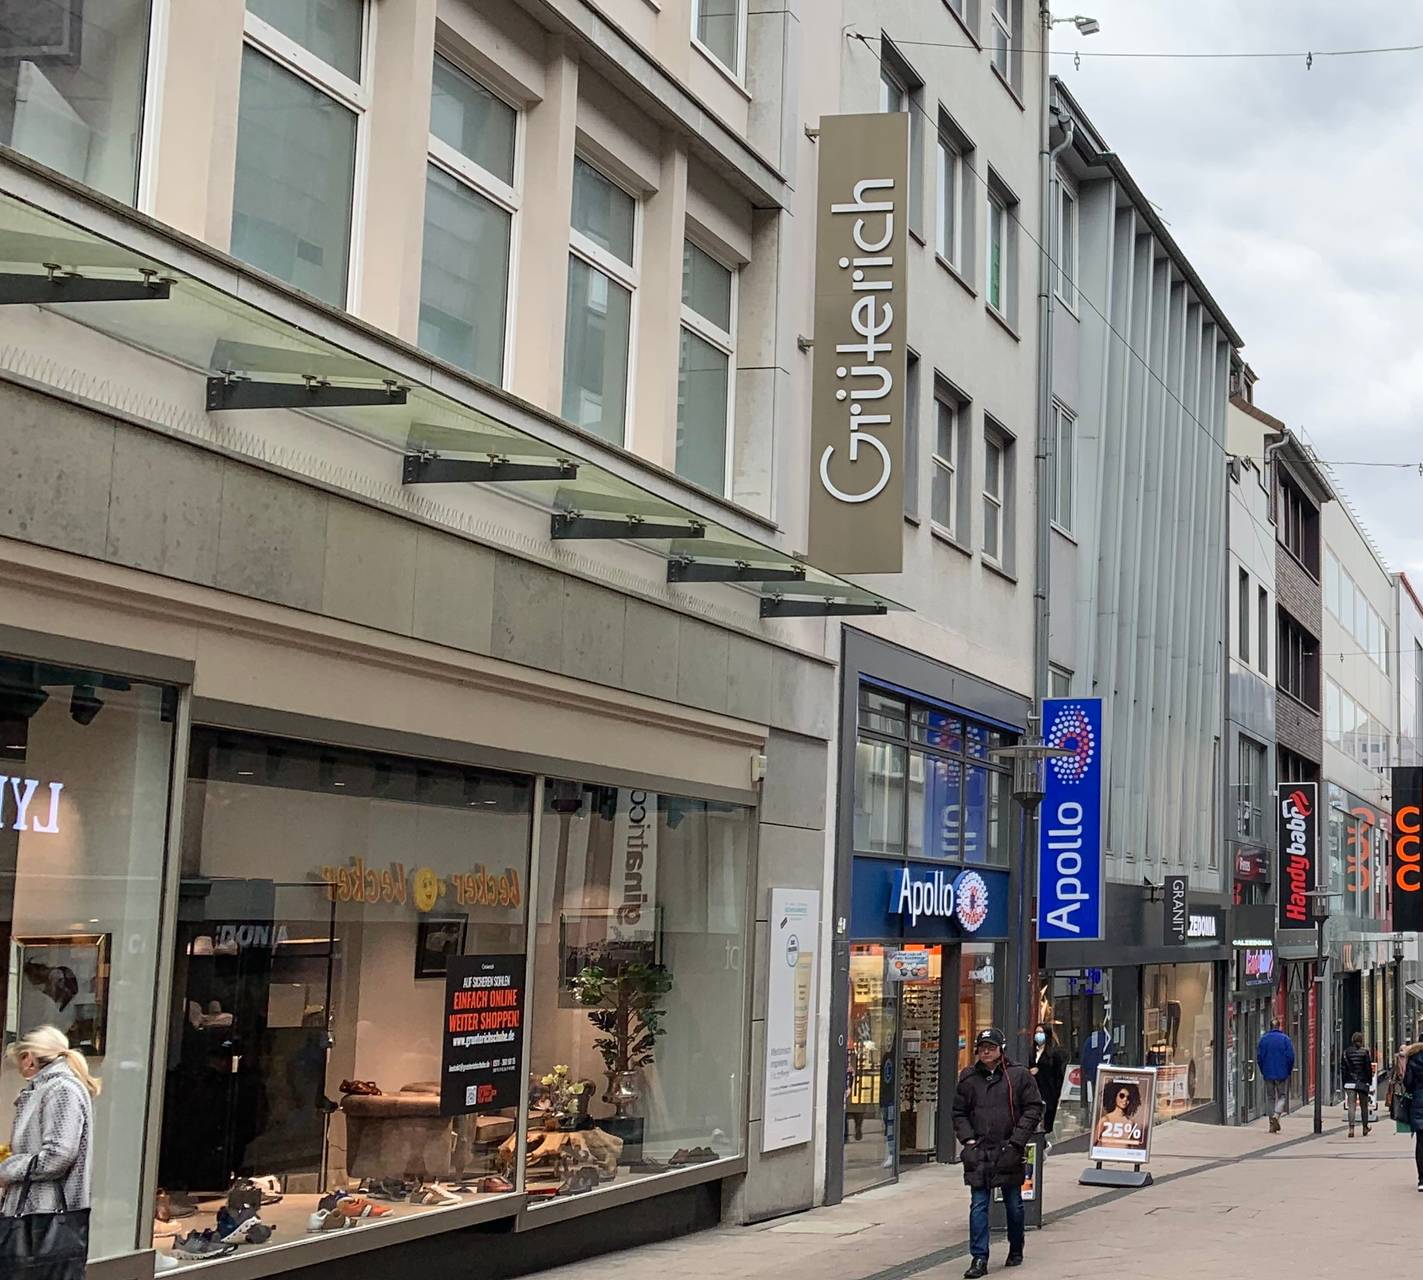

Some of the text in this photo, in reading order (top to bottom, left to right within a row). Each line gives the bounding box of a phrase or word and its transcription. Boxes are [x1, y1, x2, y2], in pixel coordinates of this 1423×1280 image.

[819, 178, 895, 503] Grüterich
[1046, 801, 1090, 934] Apollo
[1395, 805, 1421, 893] CCC
[897, 867, 955, 928] Apollo
[1187, 915, 1217, 937] ZEDONIA
[453, 989, 518, 1010] EINFACH ONLINE
[448, 1010, 520, 1033] WEITER SHOPPEN!
[1101, 1121, 1142, 1140] 25%
